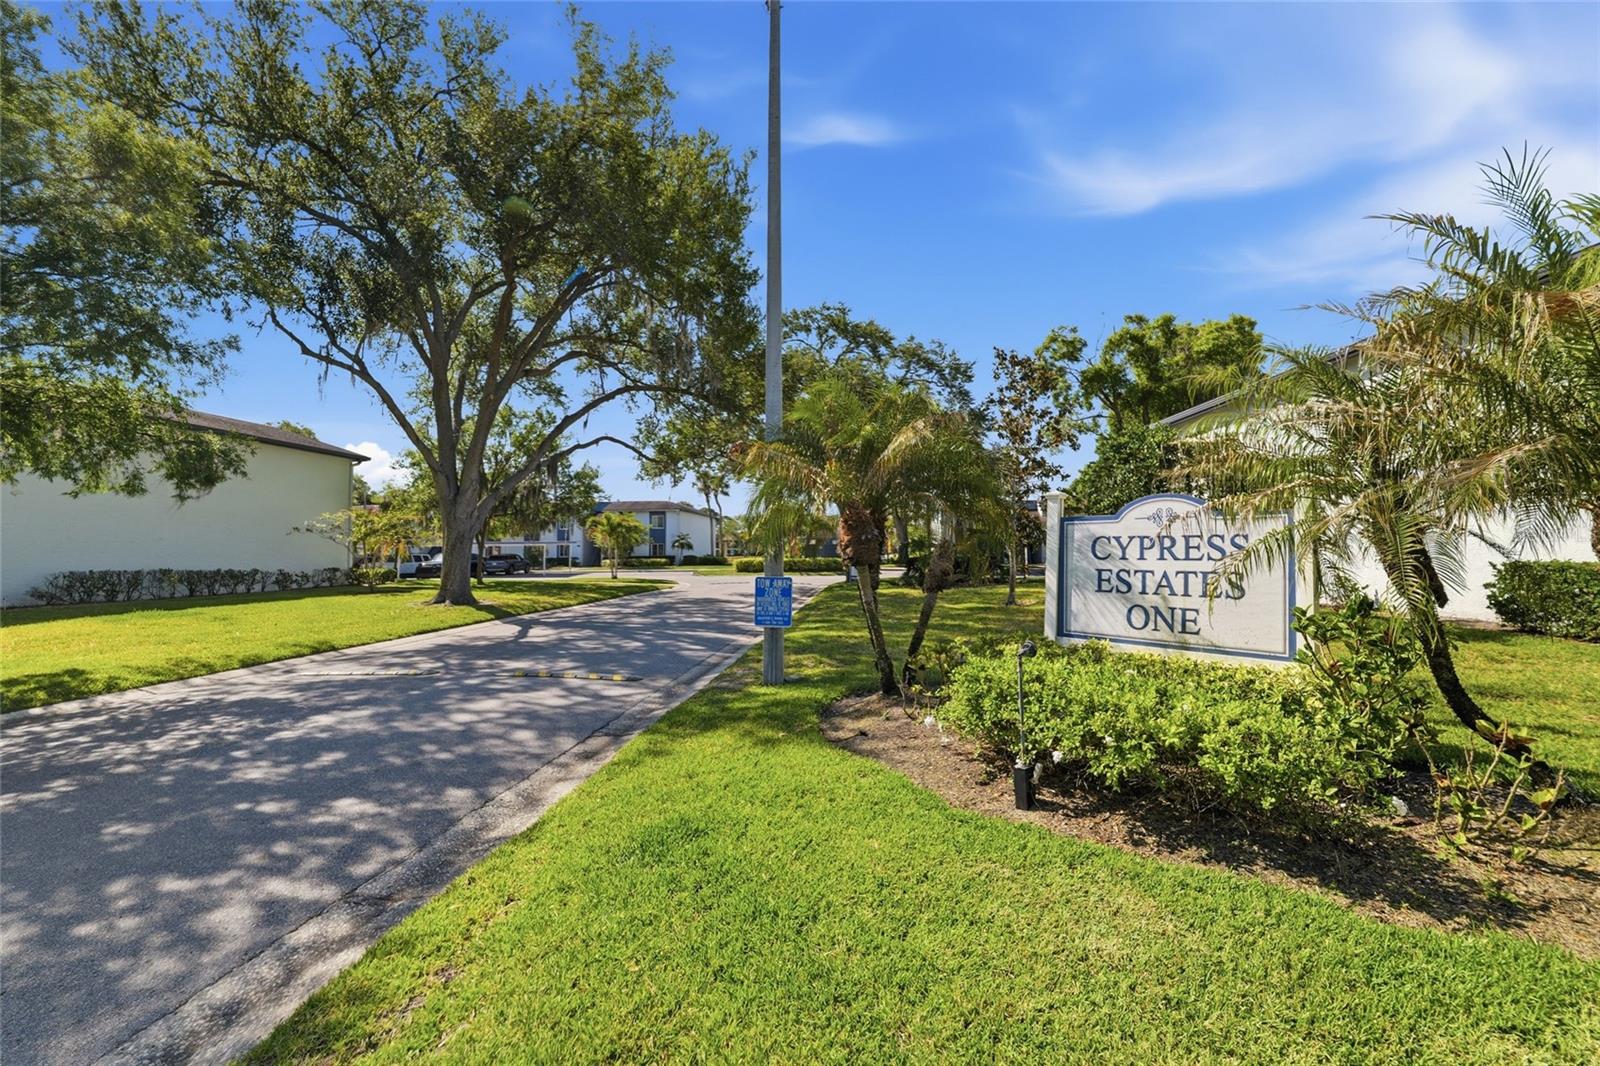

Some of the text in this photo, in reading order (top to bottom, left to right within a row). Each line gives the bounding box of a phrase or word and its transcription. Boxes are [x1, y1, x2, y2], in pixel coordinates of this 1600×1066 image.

[764, 588, 782, 597] ZONE
[1095, 569, 1246, 600] ESTATES
[1126, 604, 1201, 635] ONE
